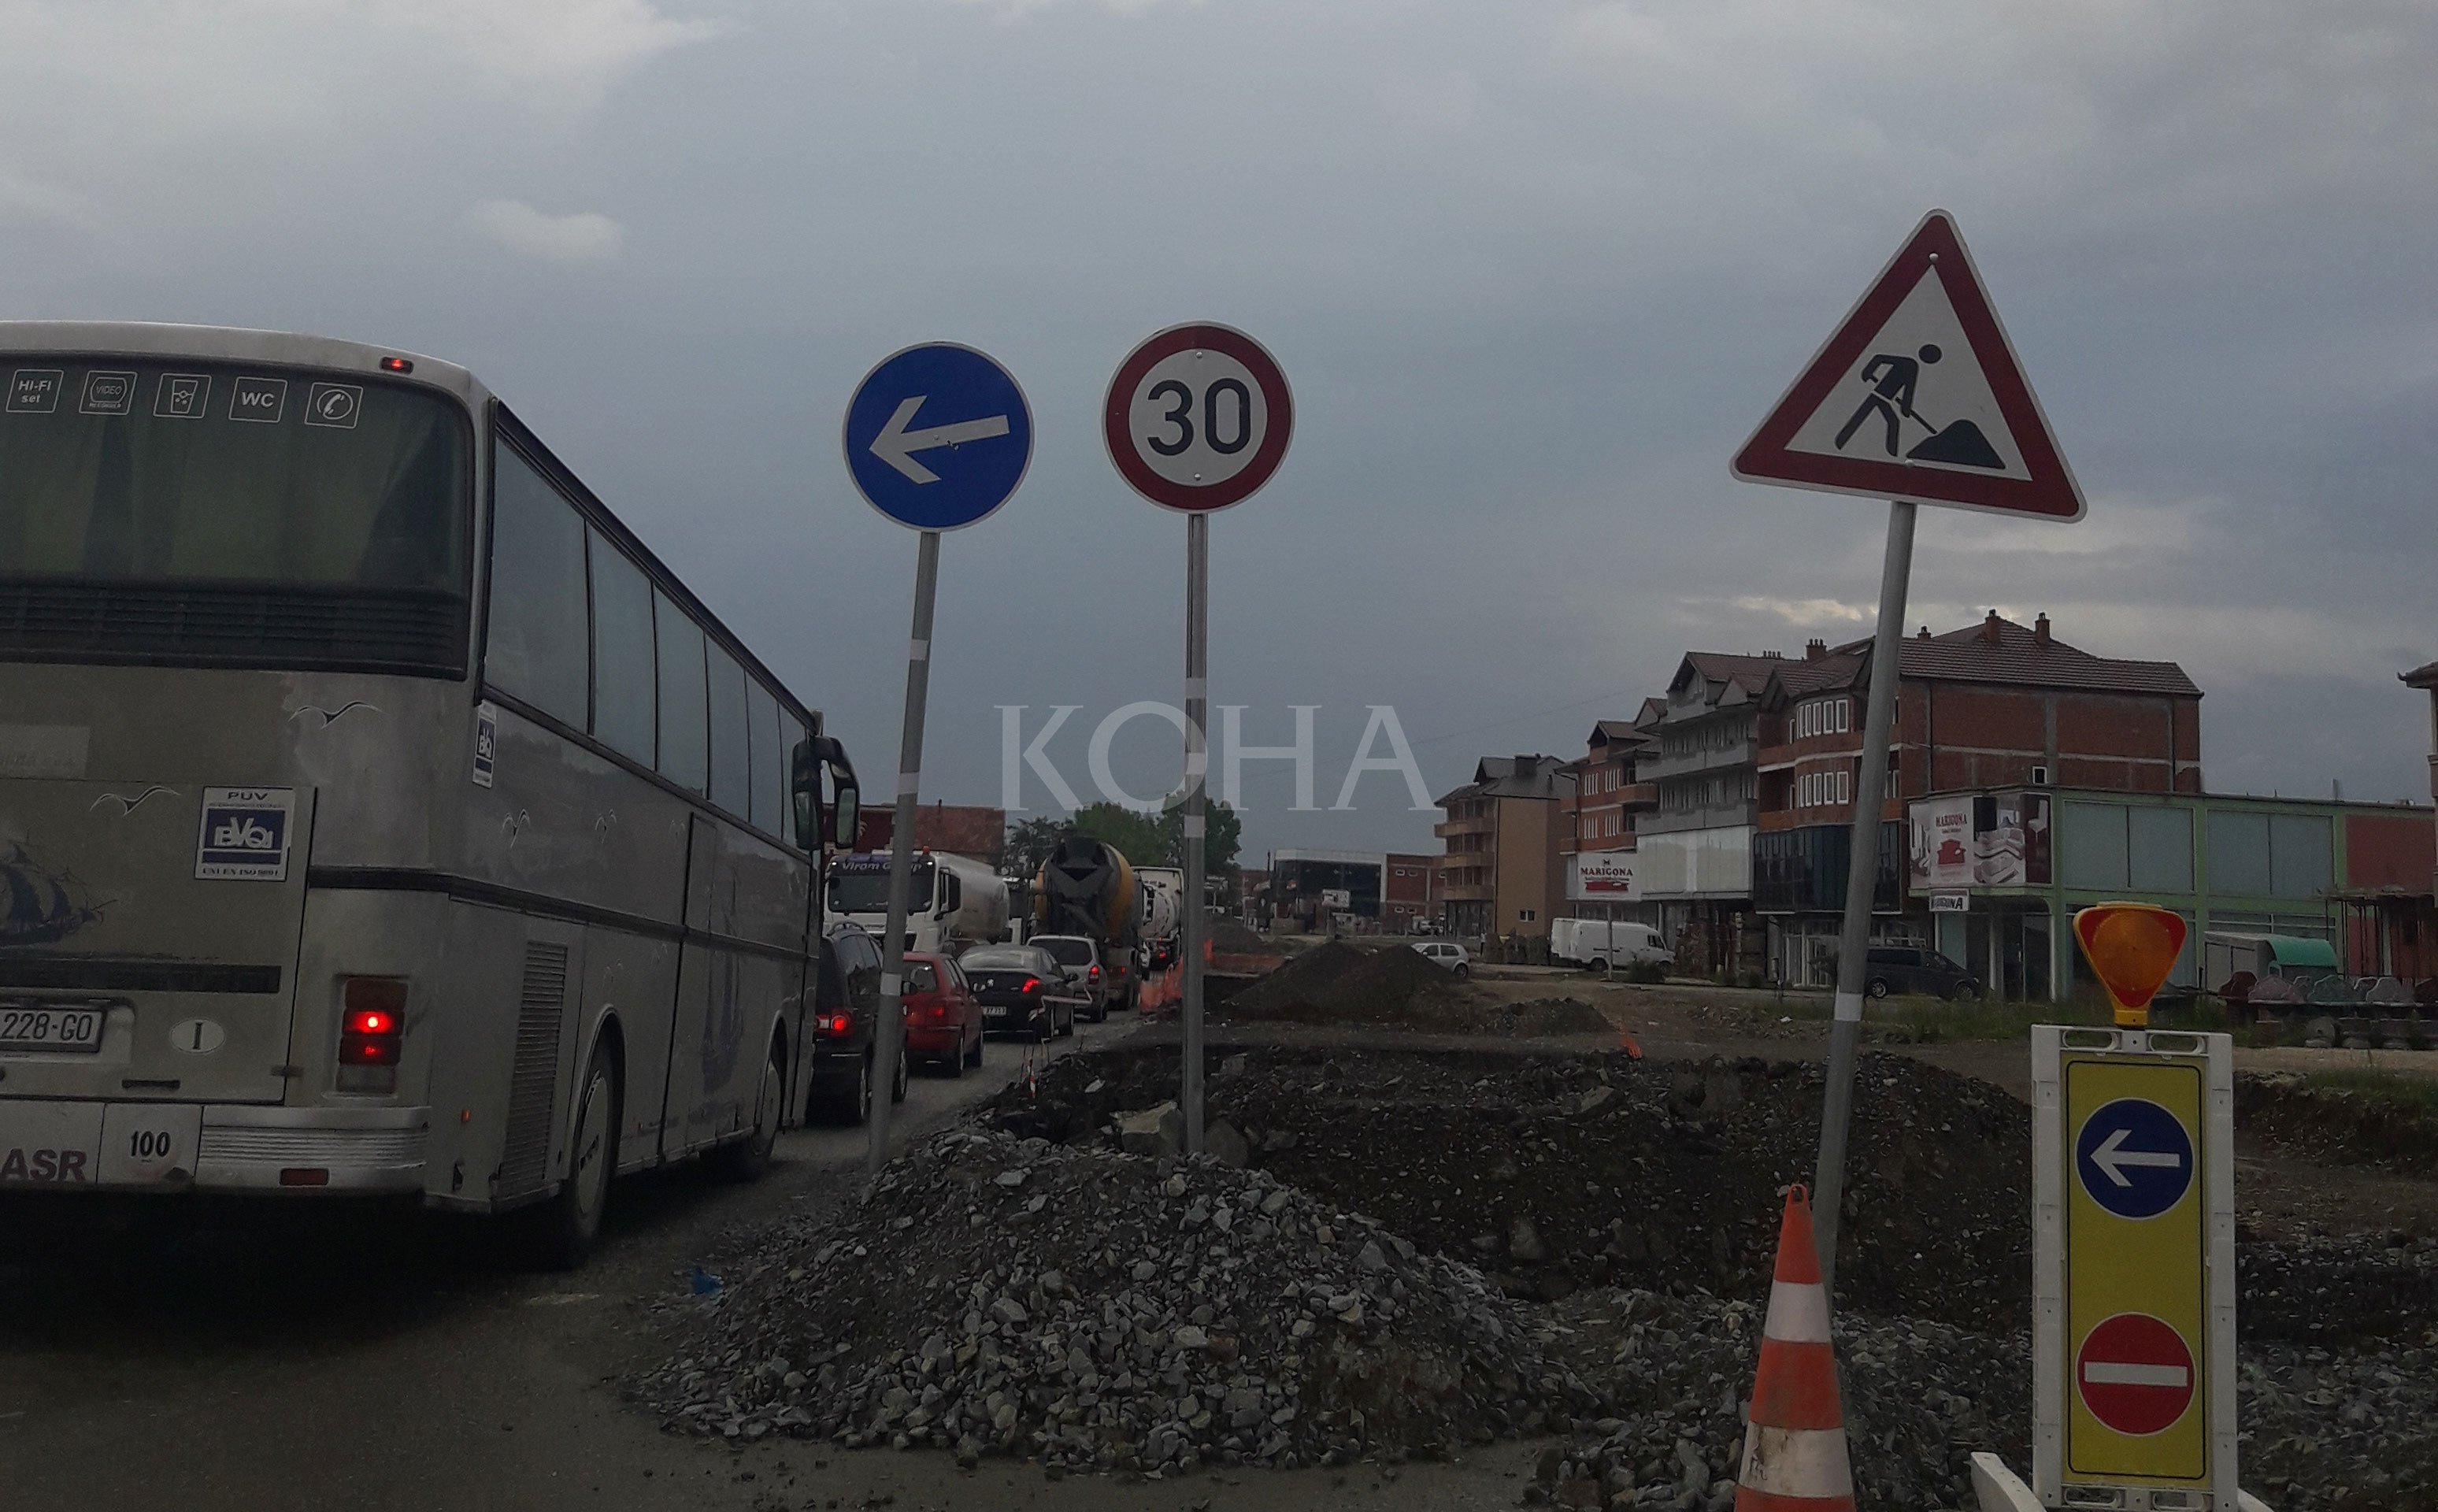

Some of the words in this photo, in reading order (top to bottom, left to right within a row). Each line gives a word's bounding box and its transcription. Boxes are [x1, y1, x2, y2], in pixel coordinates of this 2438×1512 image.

[18, 380, 52, 391] HI-FI
[95, 385, 123, 395] VIDEO
[21, 394, 41, 403] set
[241, 391, 274, 408] WC
[1147, 377, 1251, 456] 30
[228, 791, 269, 801] PUV
[1580, 867, 1633, 876] MARIGONA
[131, 1131, 171, 1157] 100
[1, 1148, 87, 1182] ASR
